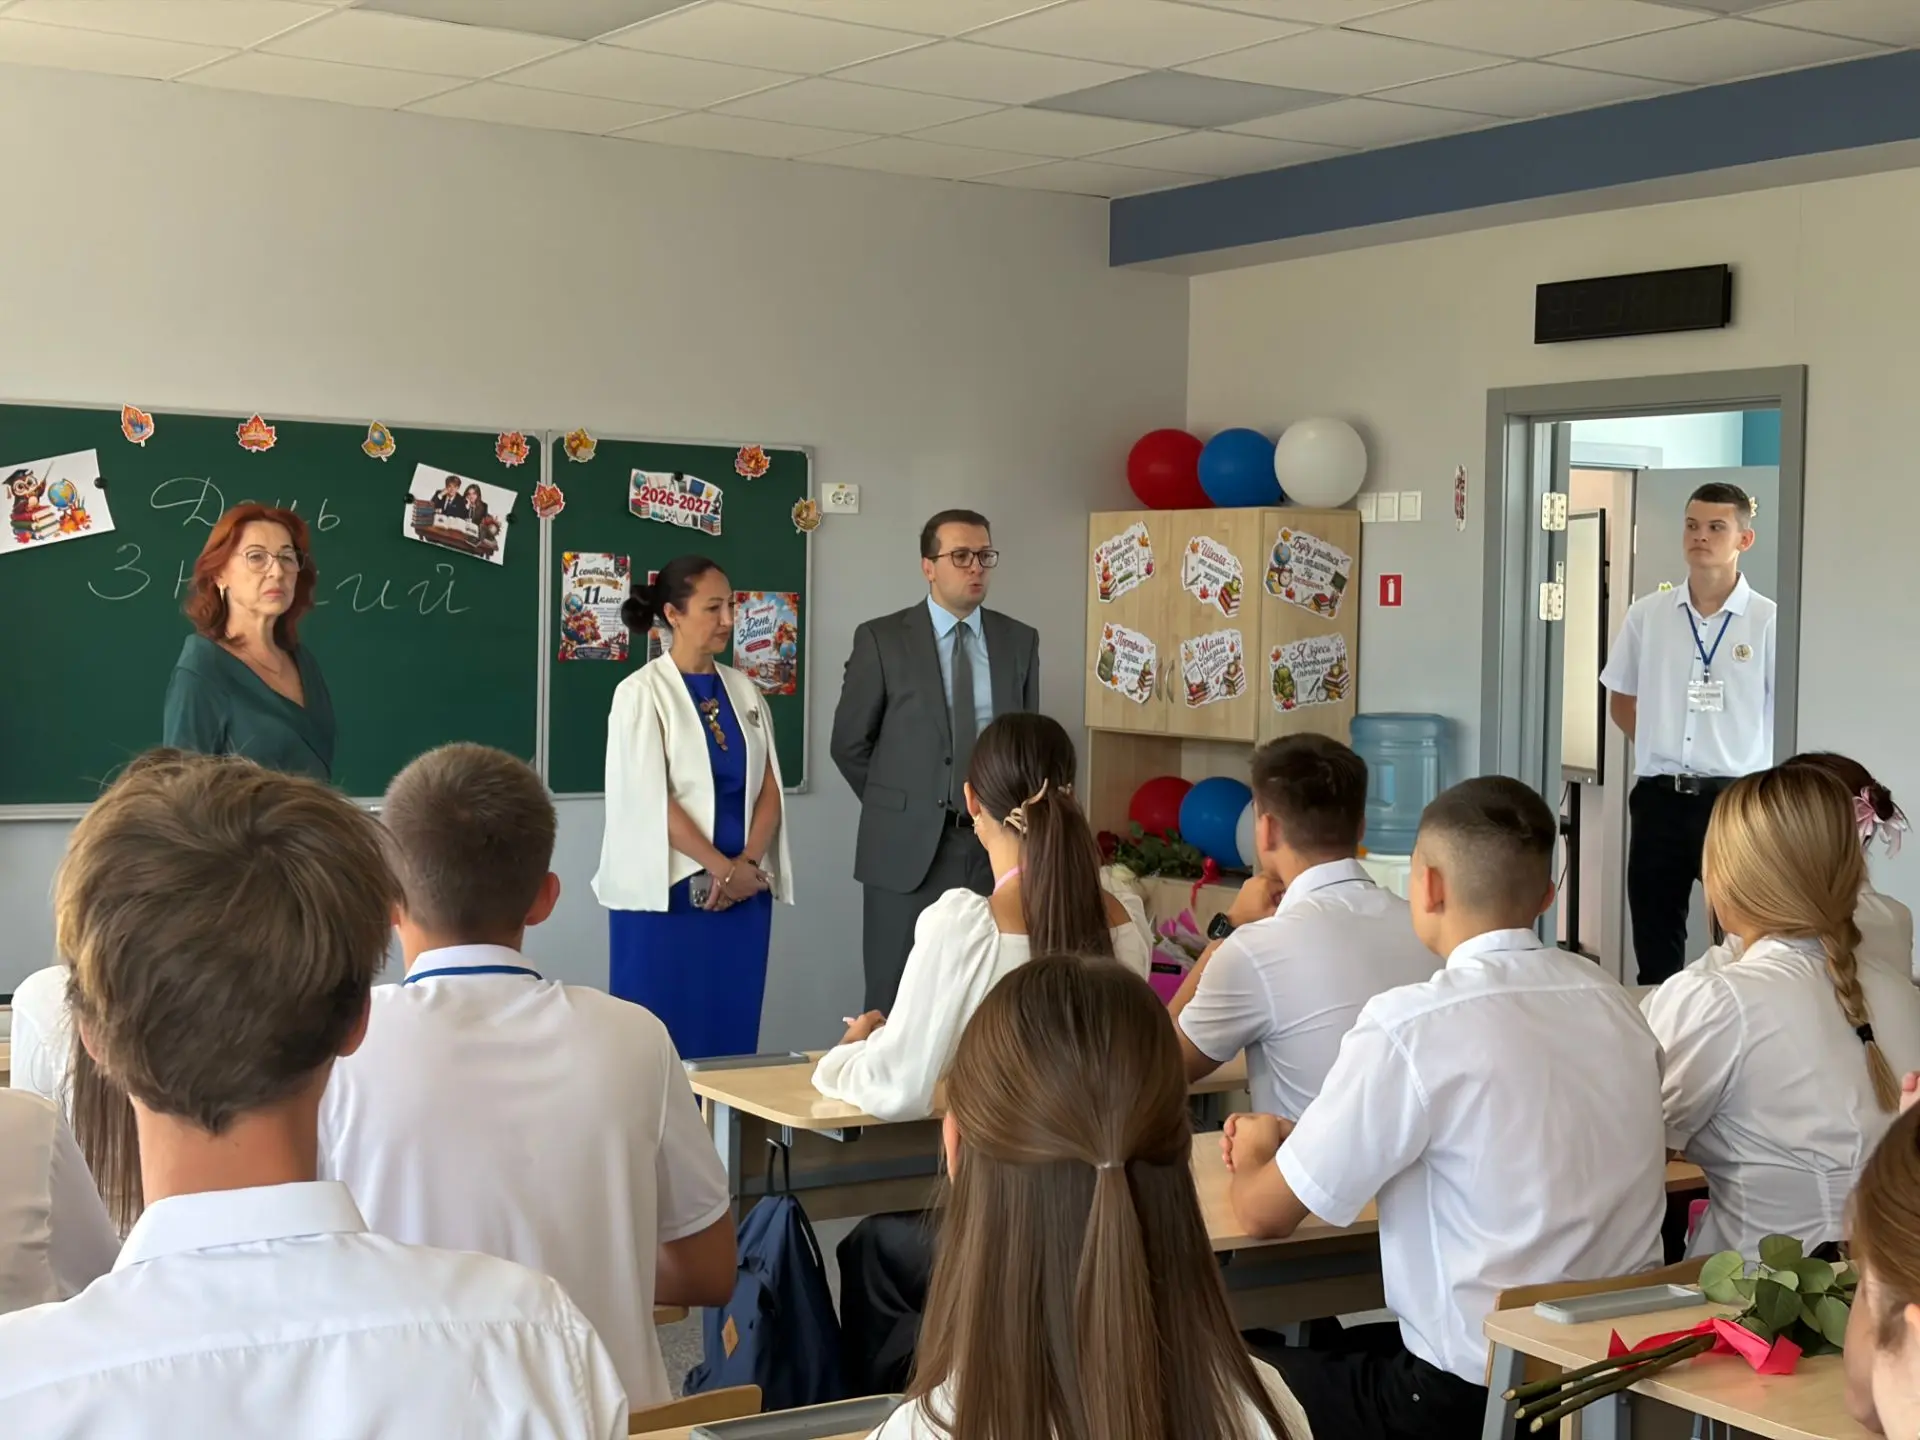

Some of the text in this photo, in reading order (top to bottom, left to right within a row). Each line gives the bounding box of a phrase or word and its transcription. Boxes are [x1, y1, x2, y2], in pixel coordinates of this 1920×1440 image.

[150, 477, 341, 532] Дь
[641, 486, 711, 514] 2026-2027
[571, 561, 579, 578] 1
[583, 586, 622, 604] 11 класс
[746, 615, 770, 631] День
